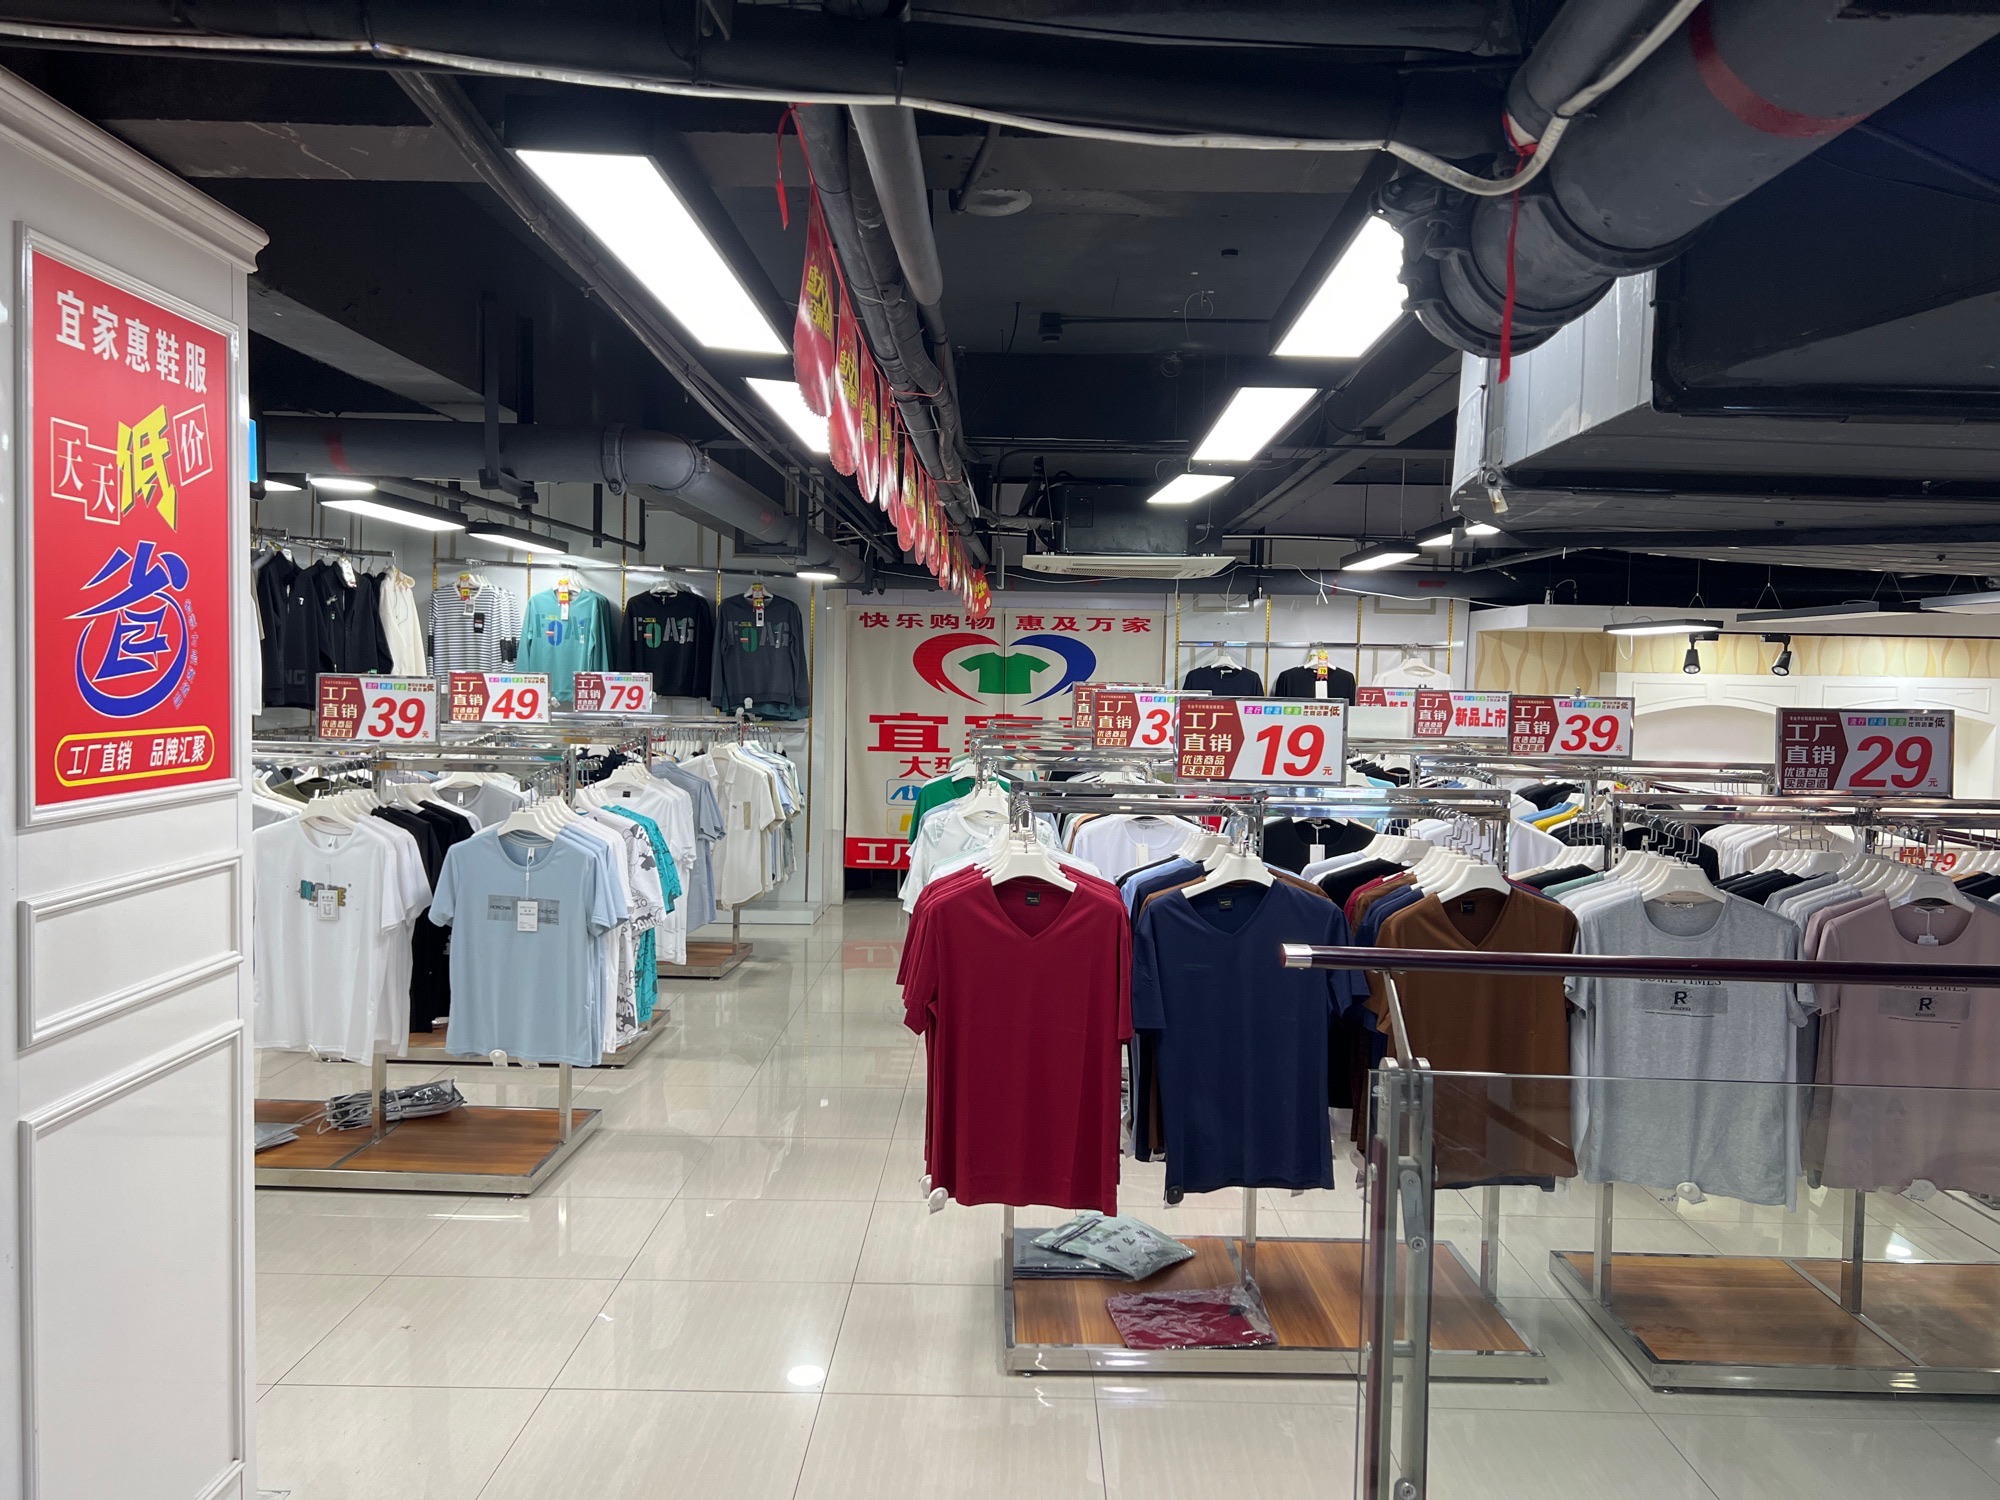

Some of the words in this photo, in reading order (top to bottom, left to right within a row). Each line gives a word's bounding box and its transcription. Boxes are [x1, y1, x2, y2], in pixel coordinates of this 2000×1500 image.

[56, 290, 207, 394] 宜家惠鞋服
[858, 612, 995, 629] 快乐购物
[1015, 615, 1151, 633] 惠及万家
[453, 681, 483, 692] 工厂
[577, 679, 601, 688] 工厂
[323, 687, 358, 701] 工厂
[453, 694, 483, 706] 直销
[609, 685, 644, 710] 79
[1360, 693, 1383, 702] 工厂
[323, 703, 358, 719] 直销
[491, 688, 539, 720] 49
[1098, 700, 1133, 713] 工厂
[1419, 698, 1448, 708] 工厂
[368, 697, 425, 739] 39
[422, 730, 429, 738] 元
[1418, 709, 1447, 721] 直销
[1455, 706, 1507, 728] 新品上市
[1514, 705, 1552, 719] 工厂
[1098, 715, 1132, 729] 直销
[1142, 709, 1174, 745] 3
[1183, 712, 1234, 731] 工厂
[1513, 720, 1551, 735] 直销
[1560, 714, 1619, 752] 39
[1615, 744, 1623, 752] 元
[1786, 724, 1837, 743] 工厂
[1183, 733, 1233, 753] 直销
[1256, 724, 1325, 777] 19
[1322, 766, 1333, 776] 元
[67, 740, 133, 775] 工厂直销
[149, 735, 206, 767] 品牌汇聚
[1182, 754, 1226, 766] 优选商品
[1785, 745, 1836, 765] 直销
[1848, 735, 1933, 788] 29
[1928, 778, 1938, 788] 元
[1784, 767, 1829, 778] 优选商品
[1673, 991, 1688, 1005] R
[1919, 997, 1933, 1011] R
